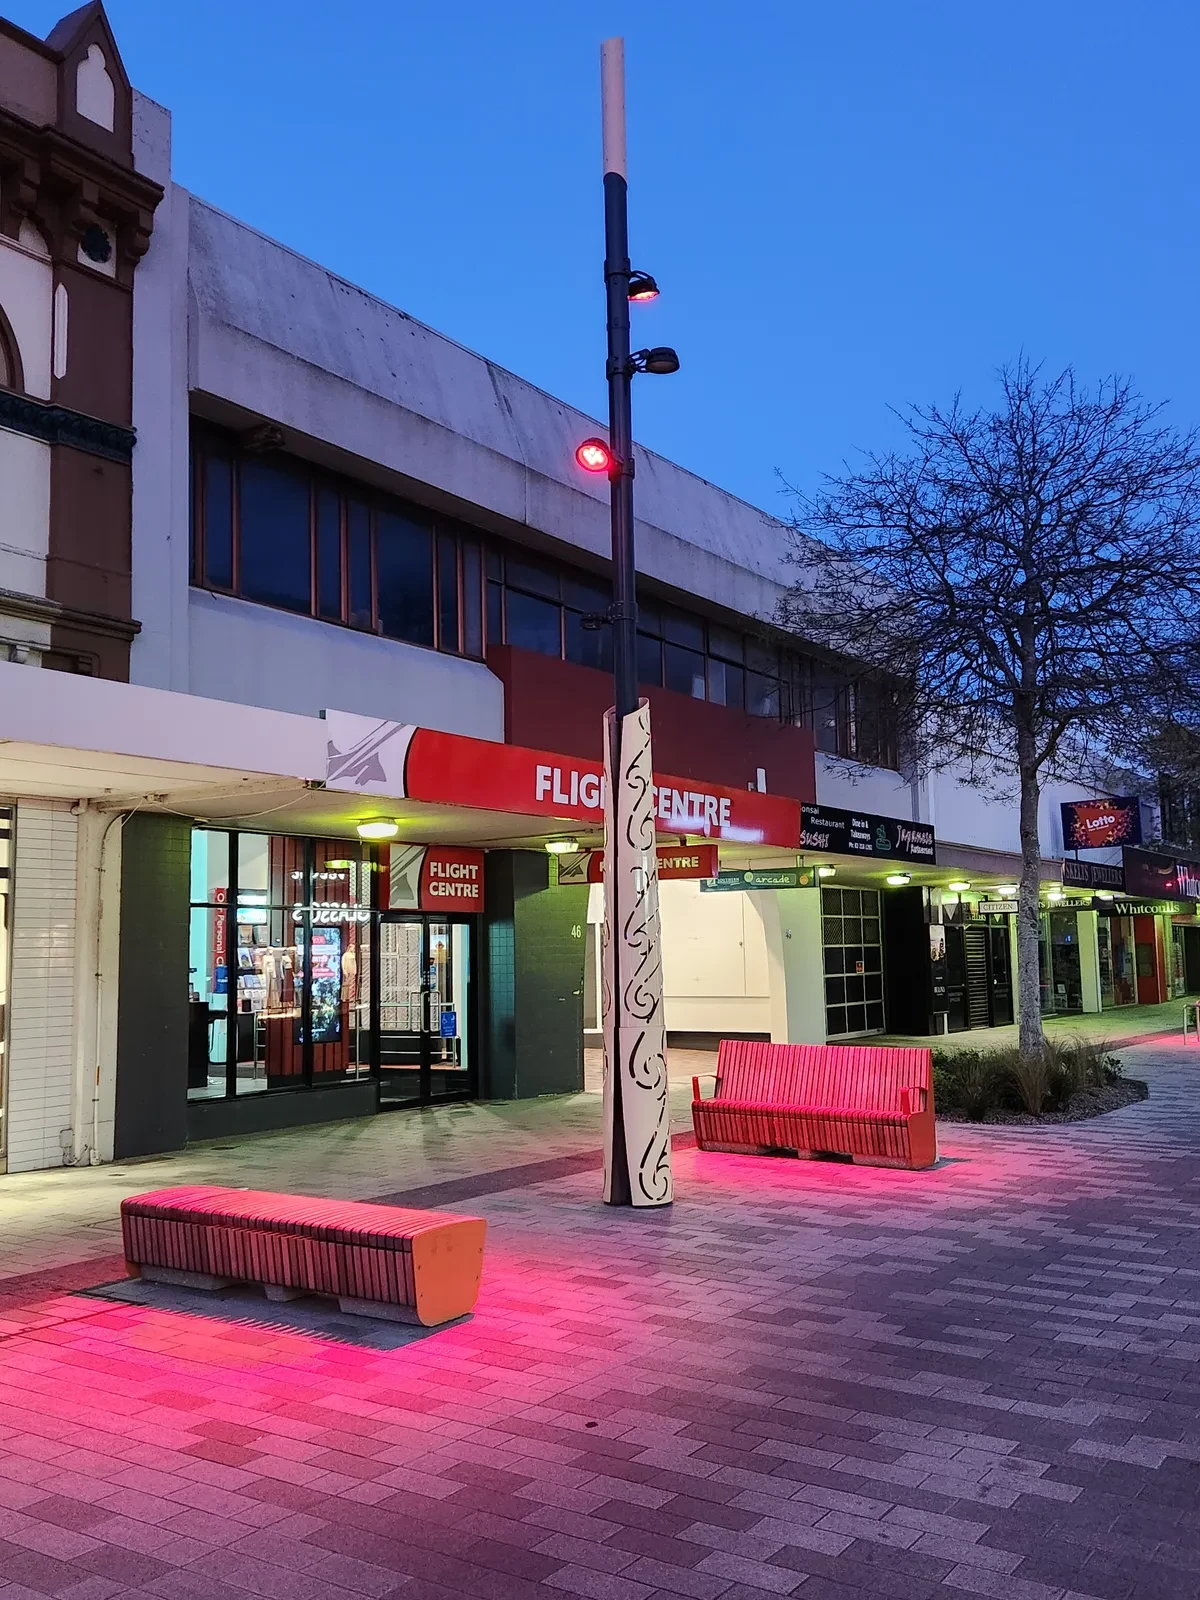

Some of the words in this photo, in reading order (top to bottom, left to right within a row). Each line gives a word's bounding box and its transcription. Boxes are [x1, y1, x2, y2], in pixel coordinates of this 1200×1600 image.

[536, 764, 605, 809] FLIG
[801, 806, 819, 815] onsai
[811, 816, 845, 829] Restaurant
[1086, 815, 1115, 829] Lotto
[656, 856, 699, 869] ENTRE
[430, 861, 479, 880] FLIGHT
[755, 874, 790, 884] arcade
[429, 881, 479, 898] CENTRE
[983, 903, 1013, 911] CITIZEN
[1046, 899, 1091, 909] JEWELLERS
[1115, 900, 1180, 915] Whitcoulls
[217, 915, 225, 954] Personal
[571, 924, 582, 938] 46
